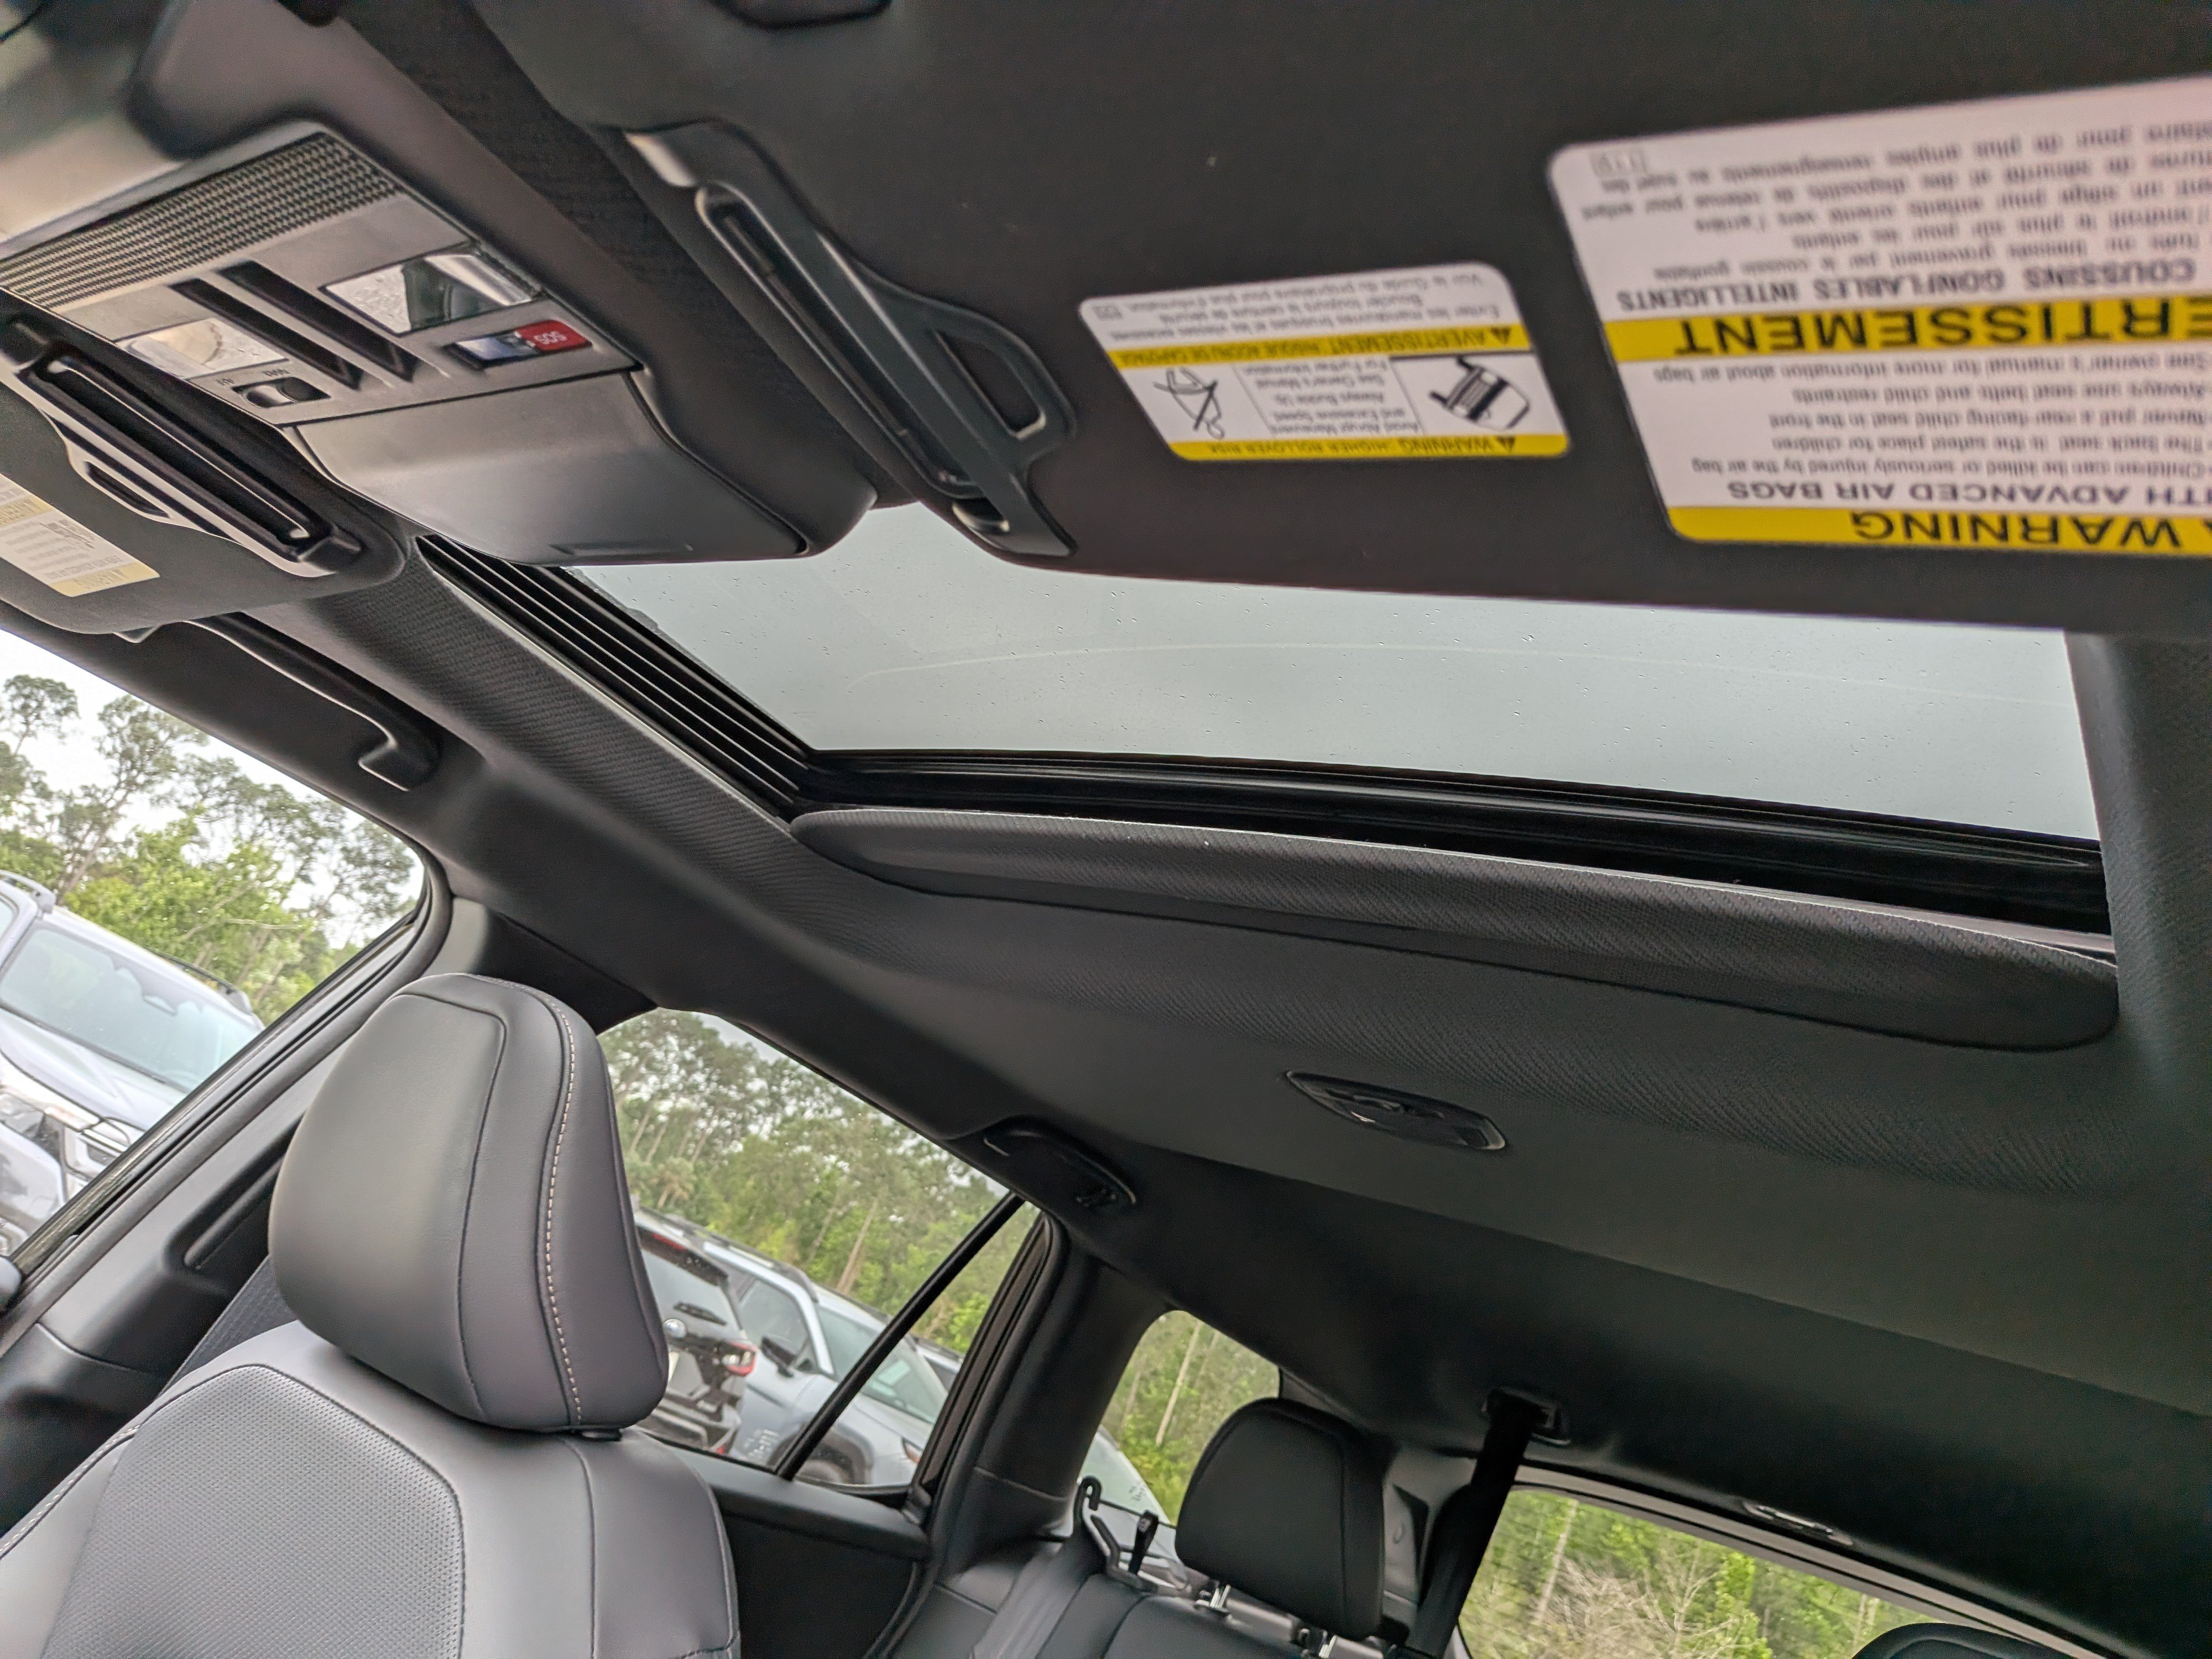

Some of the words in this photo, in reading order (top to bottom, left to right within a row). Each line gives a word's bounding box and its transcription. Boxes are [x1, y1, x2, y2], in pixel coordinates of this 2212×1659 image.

[2022, 257, 2196, 293] COUSSINS
[1813, 269, 2005, 301] GONFLABLES
[1616, 281, 1800, 312] INTELLIGENTS
[533, 331, 567, 344] SOS
[1652, 366, 1694, 385] bags
[1699, 367, 1720, 384] air
[1724, 364, 1776, 383] about
[1780, 362, 1888, 381] information
[1791, 388, 1880, 405] restraints
[1770, 414, 1813, 430] front
[1815, 414, 1845, 429] the
[1848, 413, 1866, 429] in
[1871, 412, 1910, 428] seat
[1771, 437, 1843, 453] children
[1848, 437, 1874, 454] for
[1877, 433, 1925, 452] place
[1691, 457, 1723, 475] bag
[1726, 460, 1747, 475] air
[1752, 460, 1778, 476] the
[1782, 457, 1803, 476] by
[1808, 457, 1867, 478] injured
[1873, 457, 1954, 478] seriously
[1985, 461, 2038, 479] killed
[1726, 481, 1823, 500] BAGS
[1836, 482, 1896, 502] AIR
[1908, 483, 2128, 506] ADVANCED
[1850, 511, 2180, 548] WARNING
